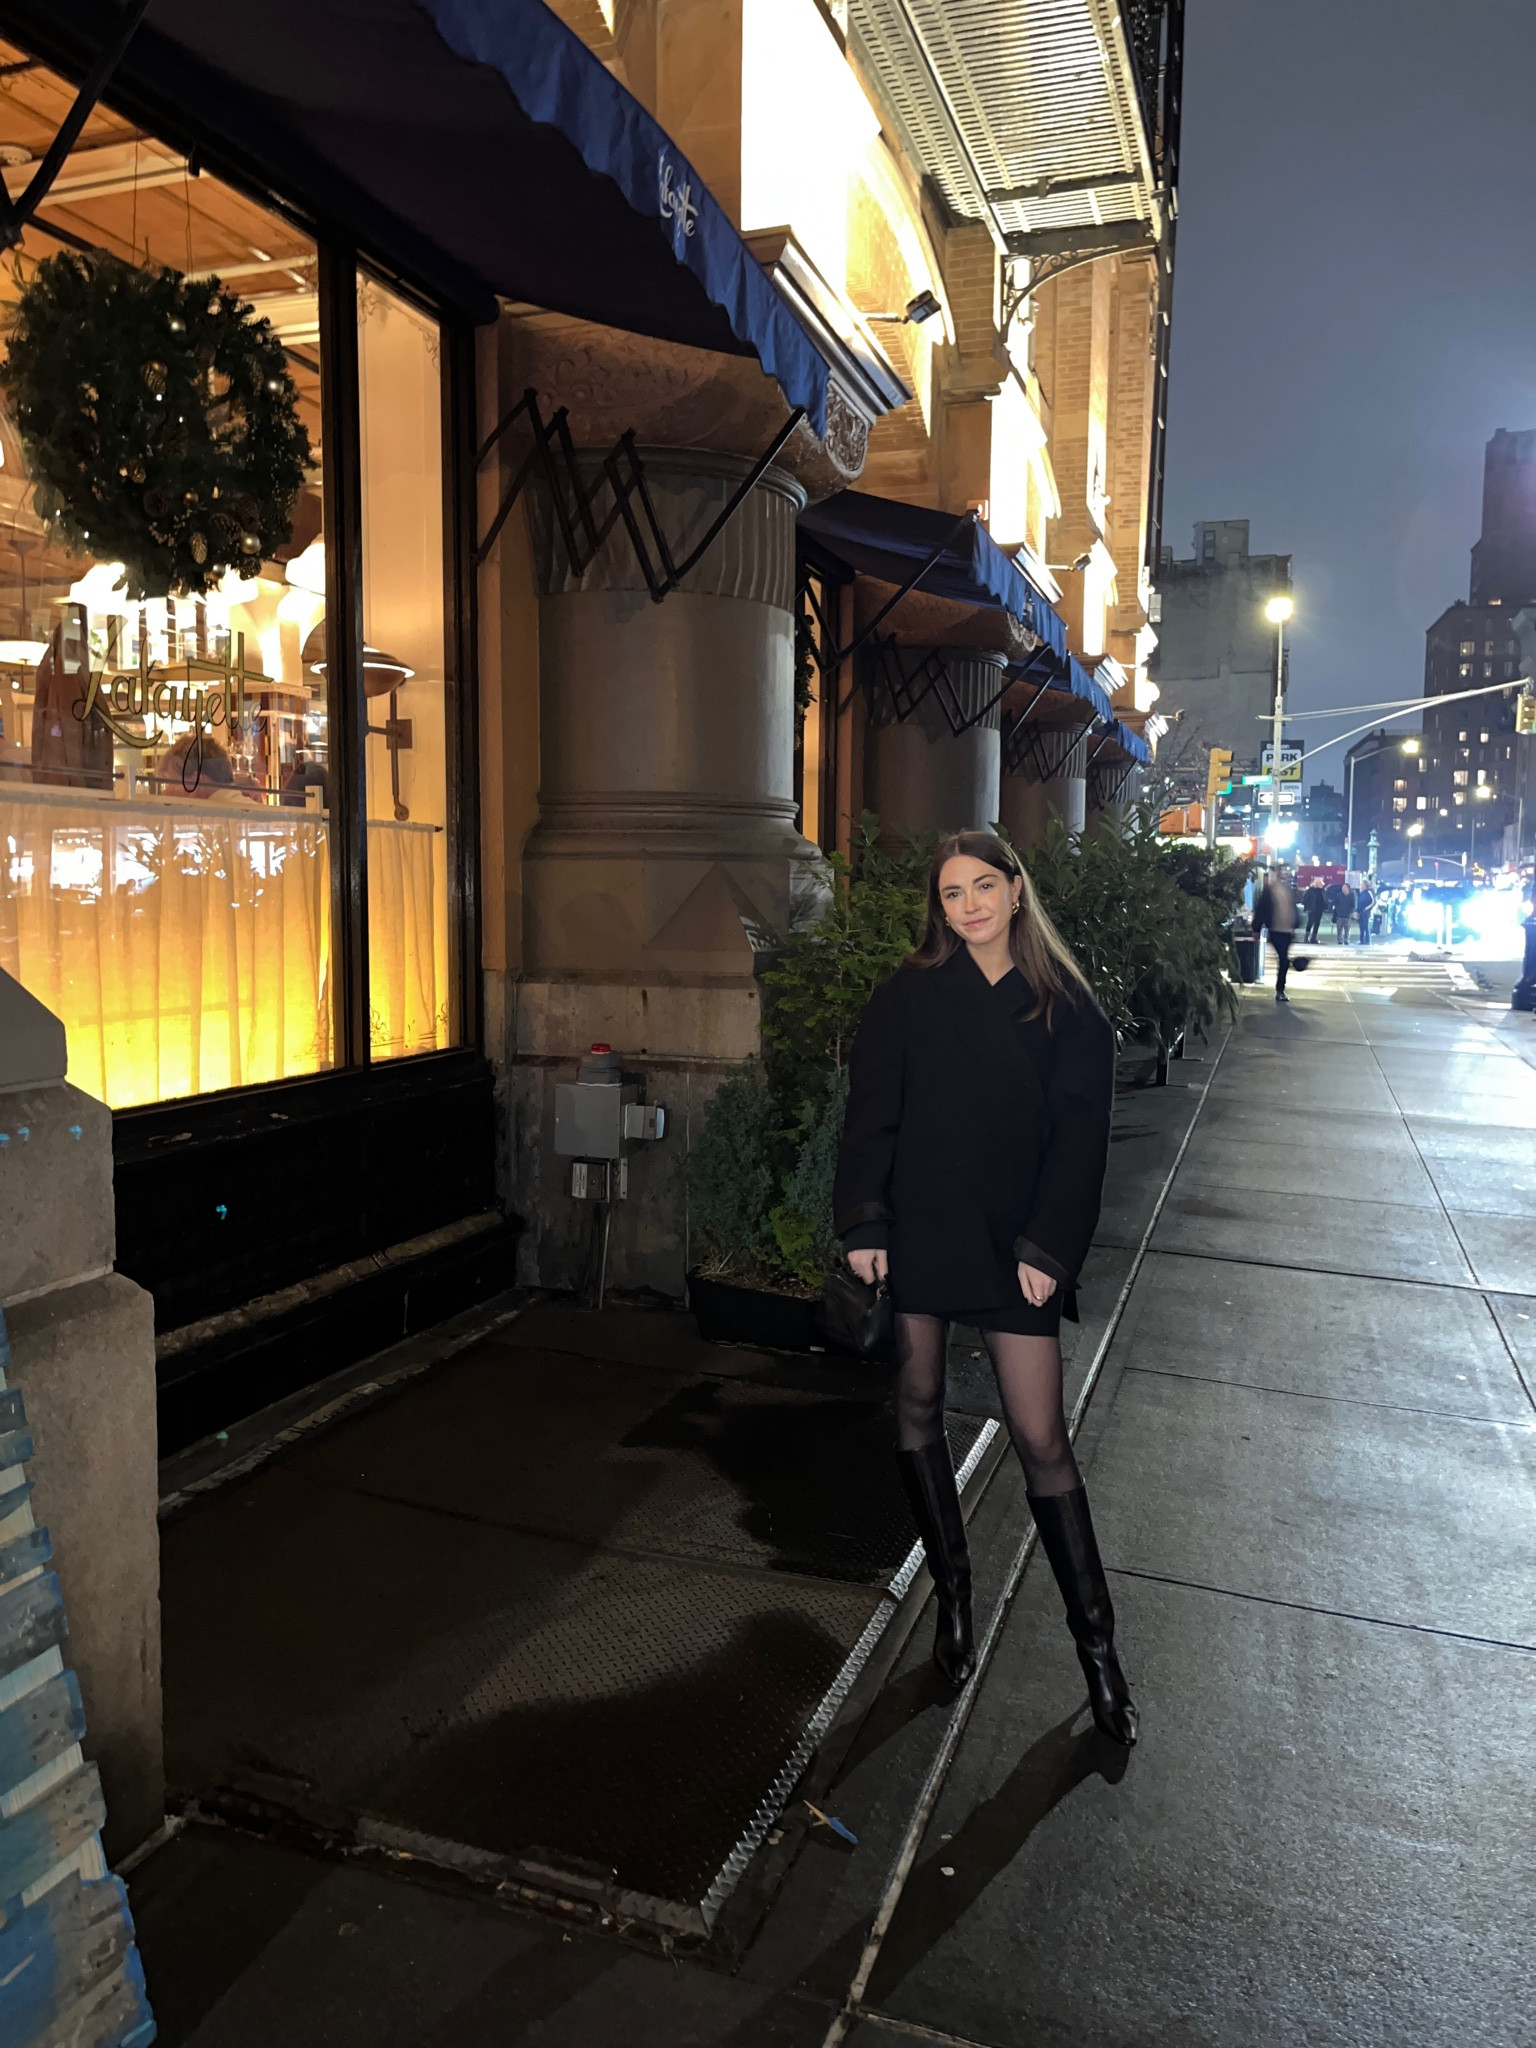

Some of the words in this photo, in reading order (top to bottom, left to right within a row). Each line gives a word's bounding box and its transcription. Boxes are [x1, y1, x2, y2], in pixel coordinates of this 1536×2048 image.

[72, 615, 274, 793] Lafayette
[1266, 753, 1298, 762] PRK
[1266, 767, 1297, 776] FST
